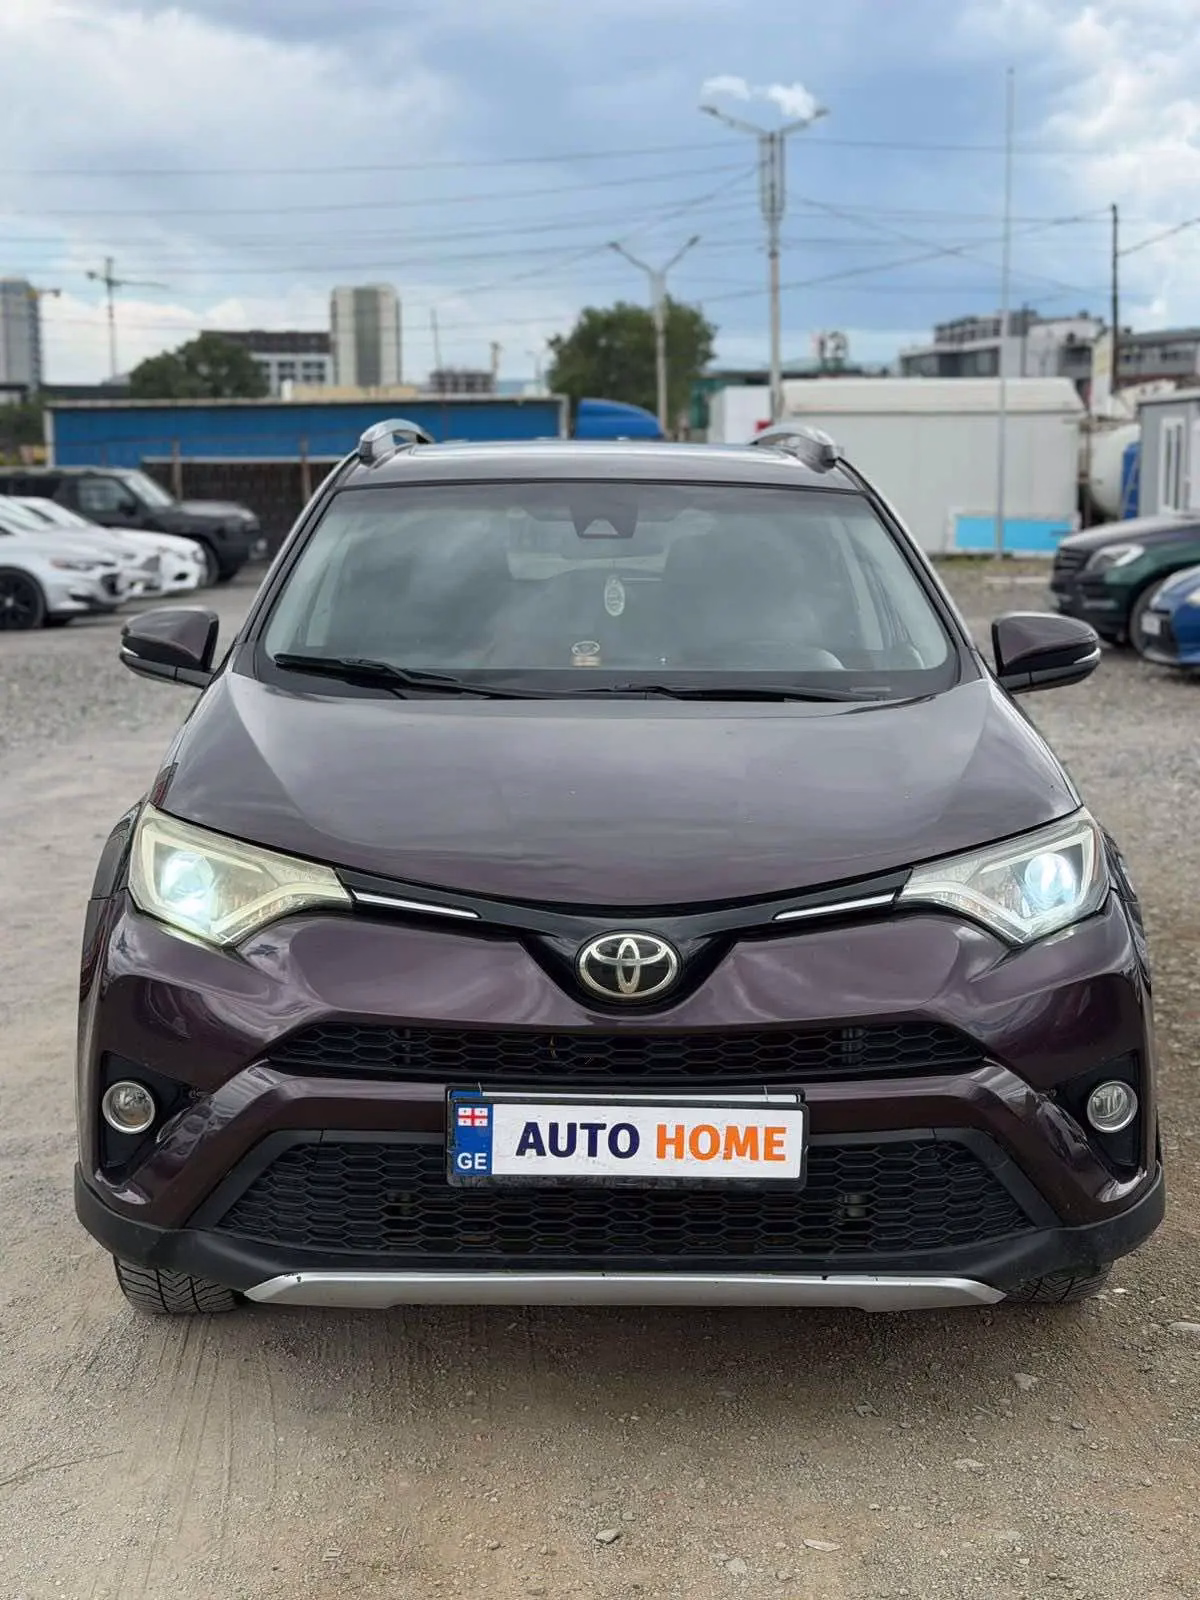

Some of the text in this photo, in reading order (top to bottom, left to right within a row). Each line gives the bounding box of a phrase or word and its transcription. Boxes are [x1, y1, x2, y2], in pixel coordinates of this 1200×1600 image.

[515, 1122, 787, 1162] AUTO HOME
[457, 1153, 487, 1170] GE
